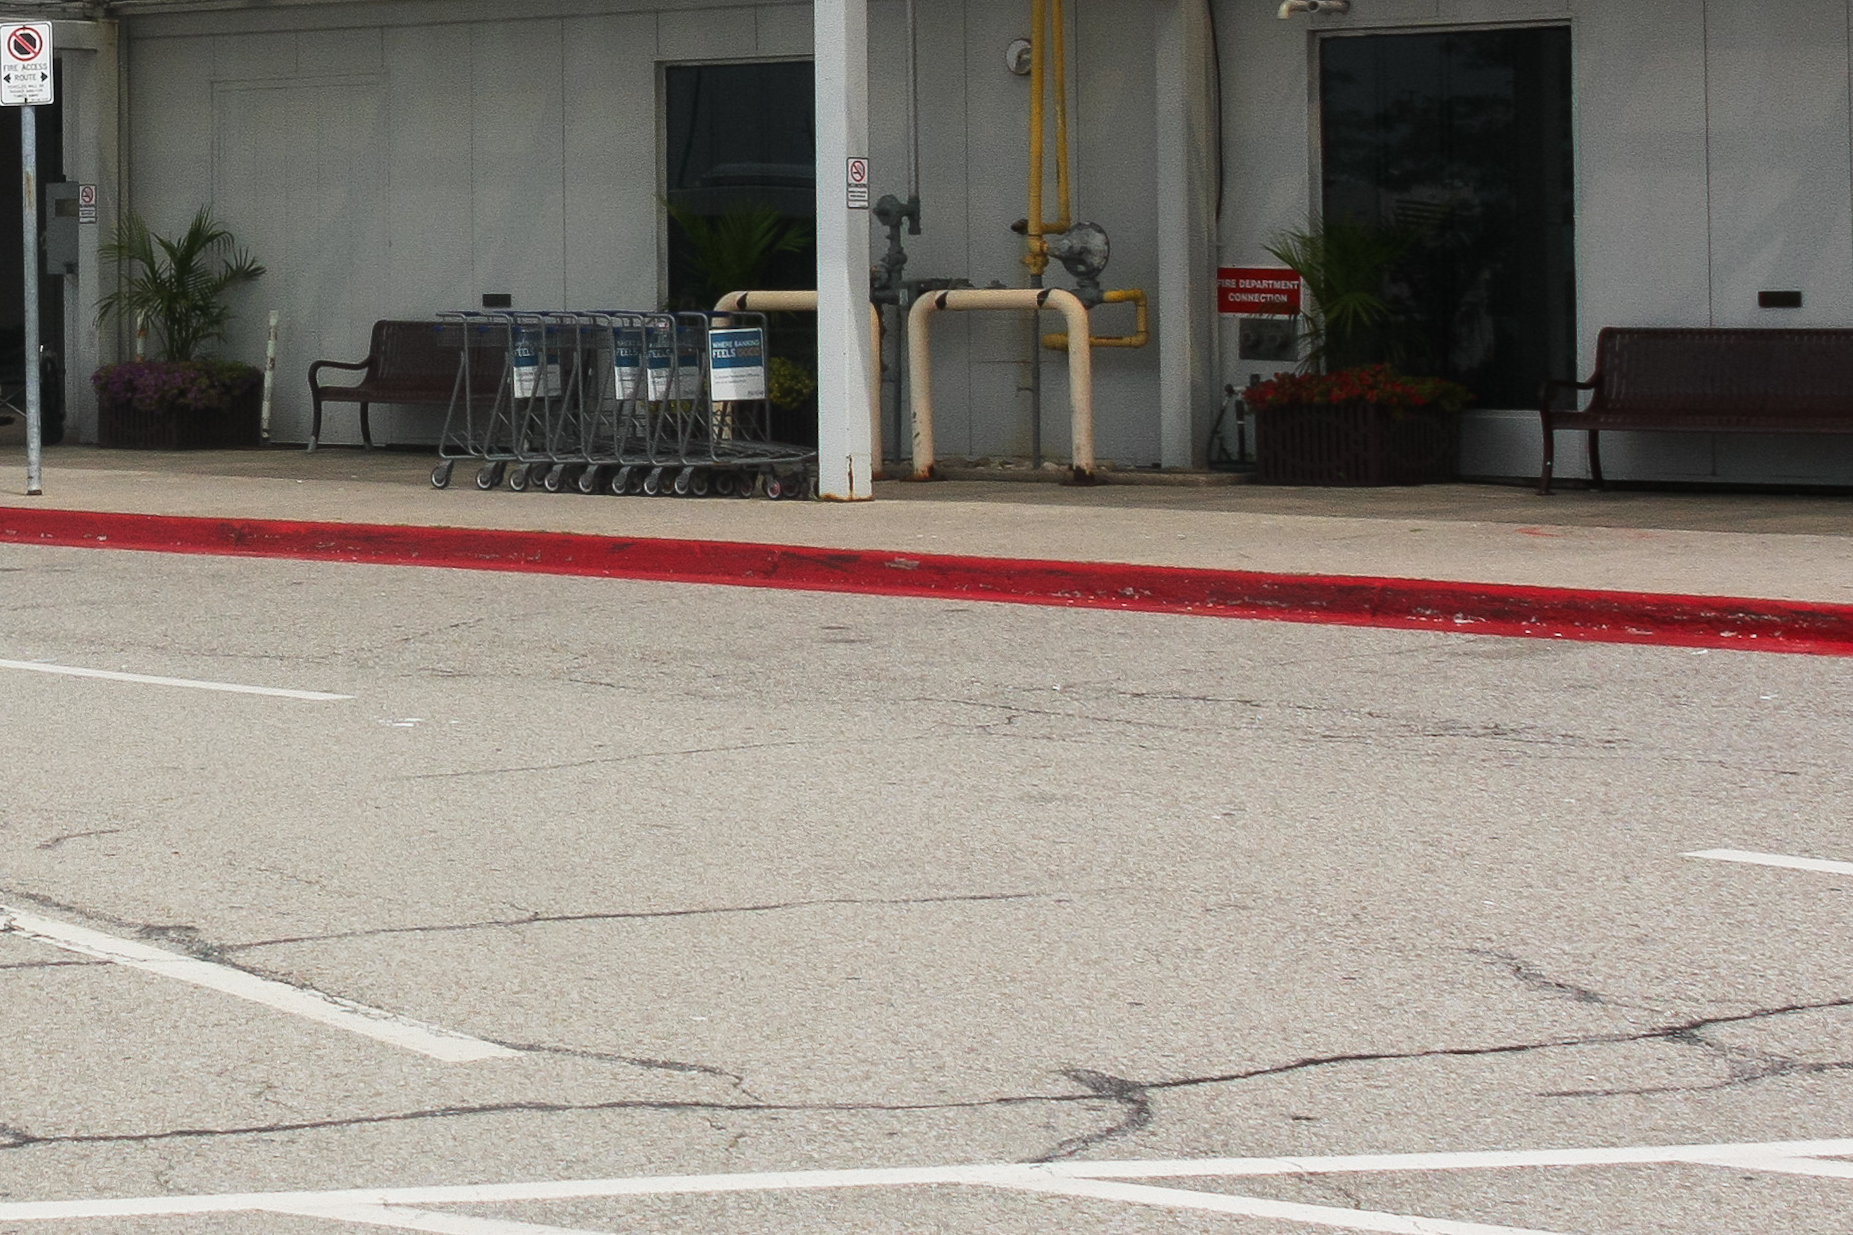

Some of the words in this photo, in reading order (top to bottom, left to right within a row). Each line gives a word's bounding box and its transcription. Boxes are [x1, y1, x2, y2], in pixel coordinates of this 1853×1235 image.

[21, 63, 48, 72] ACCESS
[14, 73, 37, 81] ROUTE
[1218, 279, 1237, 288] FIRE
[1238, 279, 1299, 289] DEPARTMENT
[1228, 292, 1288, 303] CONNECTION
[712, 348, 736, 359] FEELS
